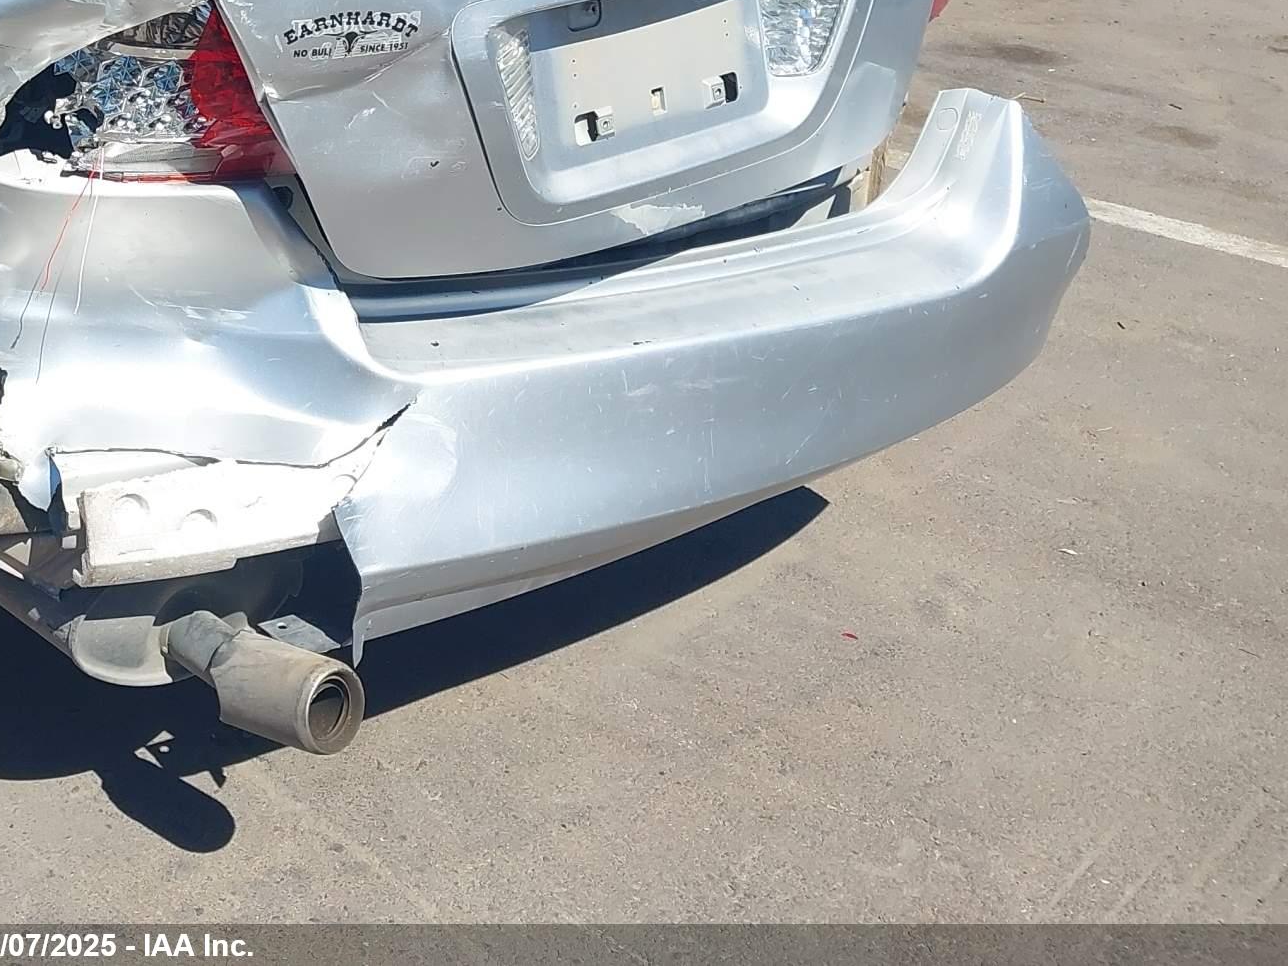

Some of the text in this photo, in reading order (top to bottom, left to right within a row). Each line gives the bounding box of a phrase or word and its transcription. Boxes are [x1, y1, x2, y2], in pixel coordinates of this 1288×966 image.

[283, 11, 419, 45] EARNHARDT
[293, 49, 309, 58] NO
[360, 44, 386, 53] SINCE
[389, 42, 409, 51] 1951
